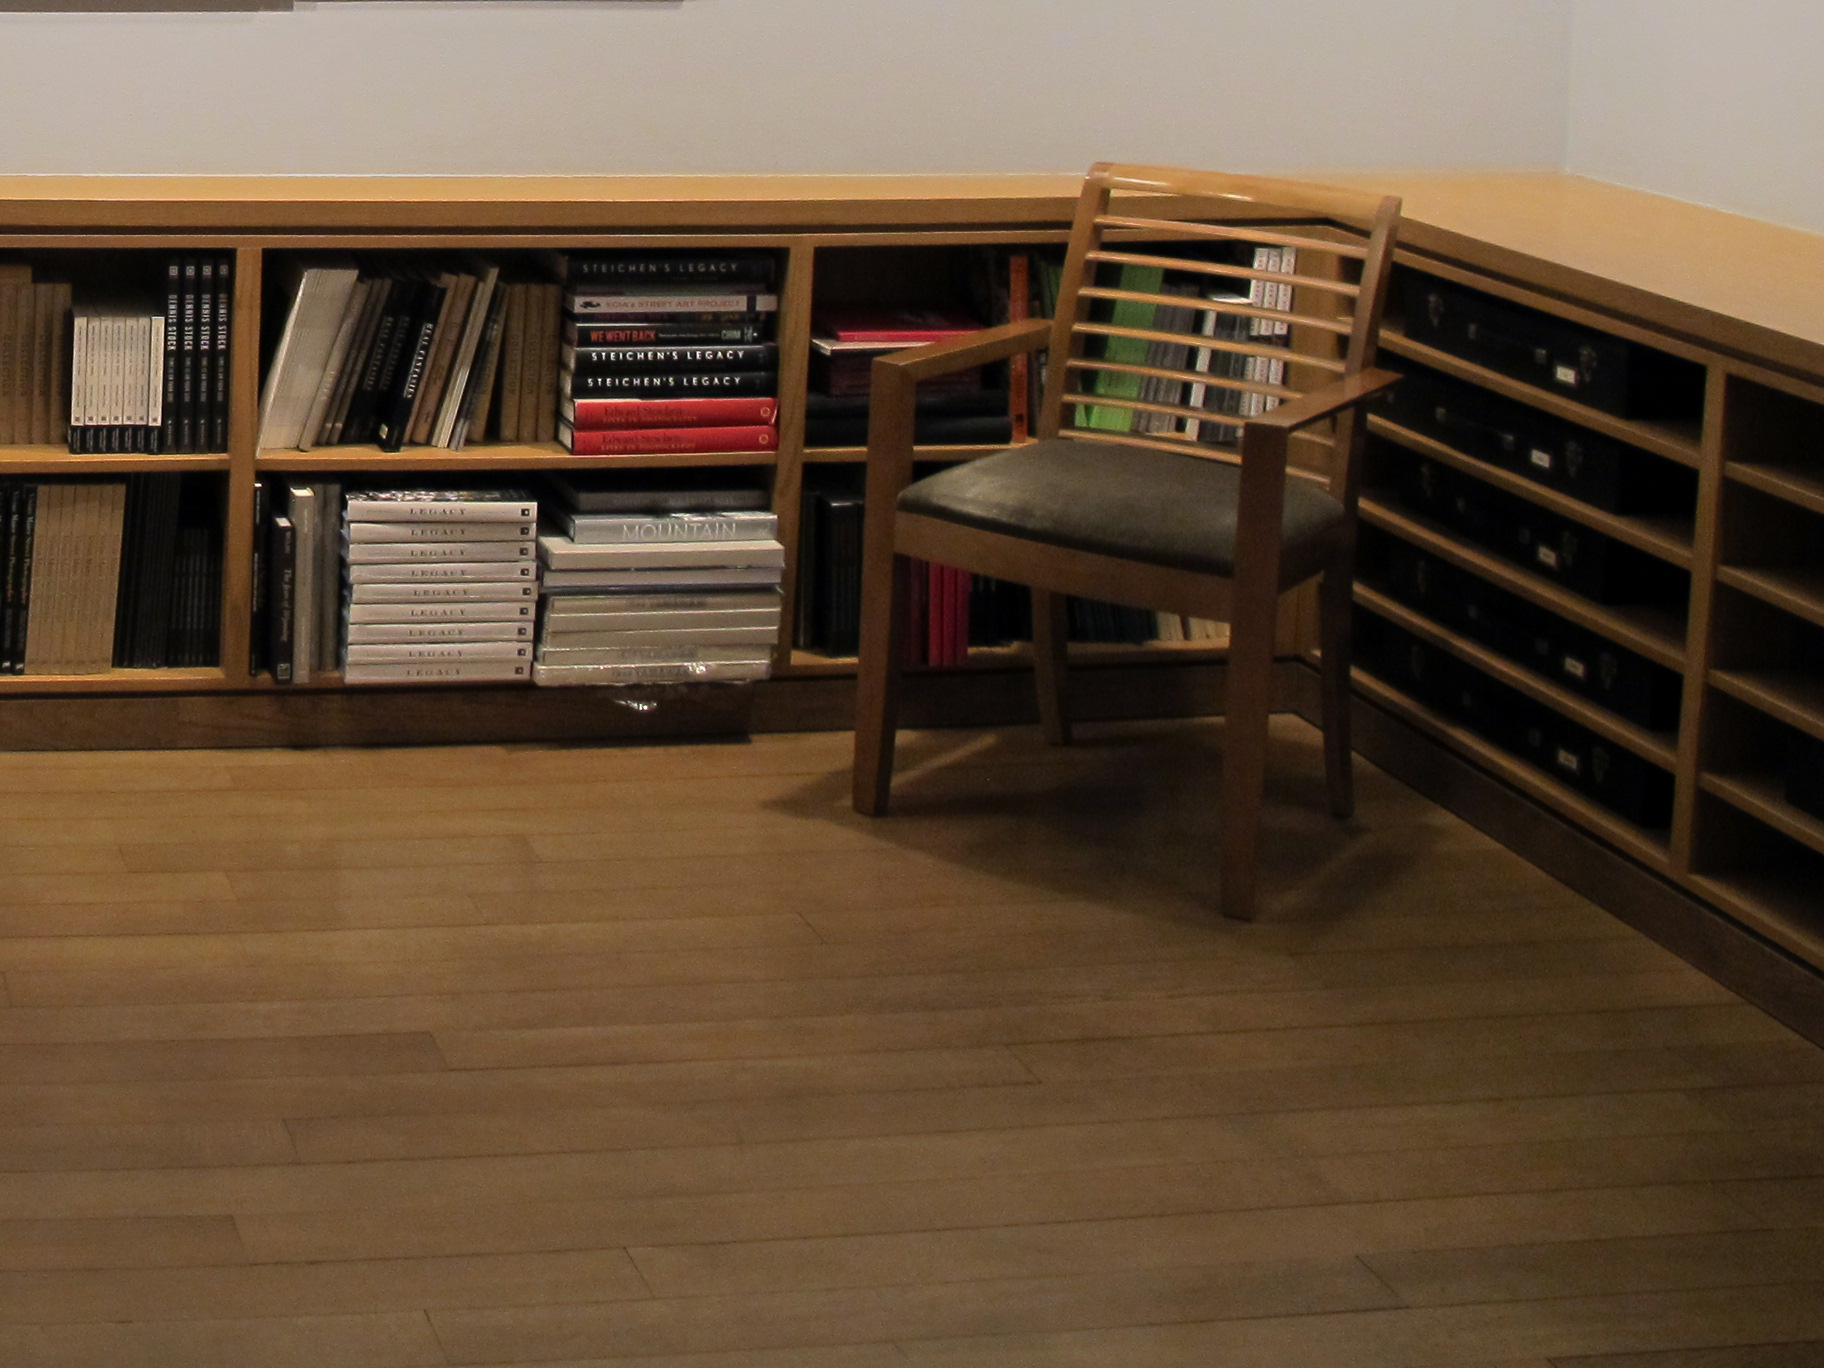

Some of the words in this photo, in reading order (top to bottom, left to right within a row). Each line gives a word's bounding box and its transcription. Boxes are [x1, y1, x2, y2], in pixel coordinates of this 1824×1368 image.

[583, 264, 670, 272] STEICHEN'S
[679, 263, 738, 272] LEGACY
[168, 294, 178, 323] DENNIS
[184, 294, 194, 322] DENNIS
[200, 294, 211, 322] DENNIS
[167, 326, 177, 351] STOCK
[184, 326, 194, 351] STOCK
[200, 326, 211, 350] STOCK
[217, 326, 227, 350] STOCK
[421, 323, 434, 346] REAL
[590, 330, 605, 342] WE
[606, 330, 631, 342] WENT
[632, 330, 656, 342] BACK
[592, 351, 678, 360] STEICHEN'S
[687, 350, 744, 360] LEGACY
[406, 350, 426, 398] FANTASIES
[588, 378, 674, 387] STEICHEN'S
[684, 377, 741, 386] LEGACY
[411, 528, 466, 536] LEGACY
[622, 523, 736, 539] MOUNTAIN
[408, 629, 464, 637] LEGACY
